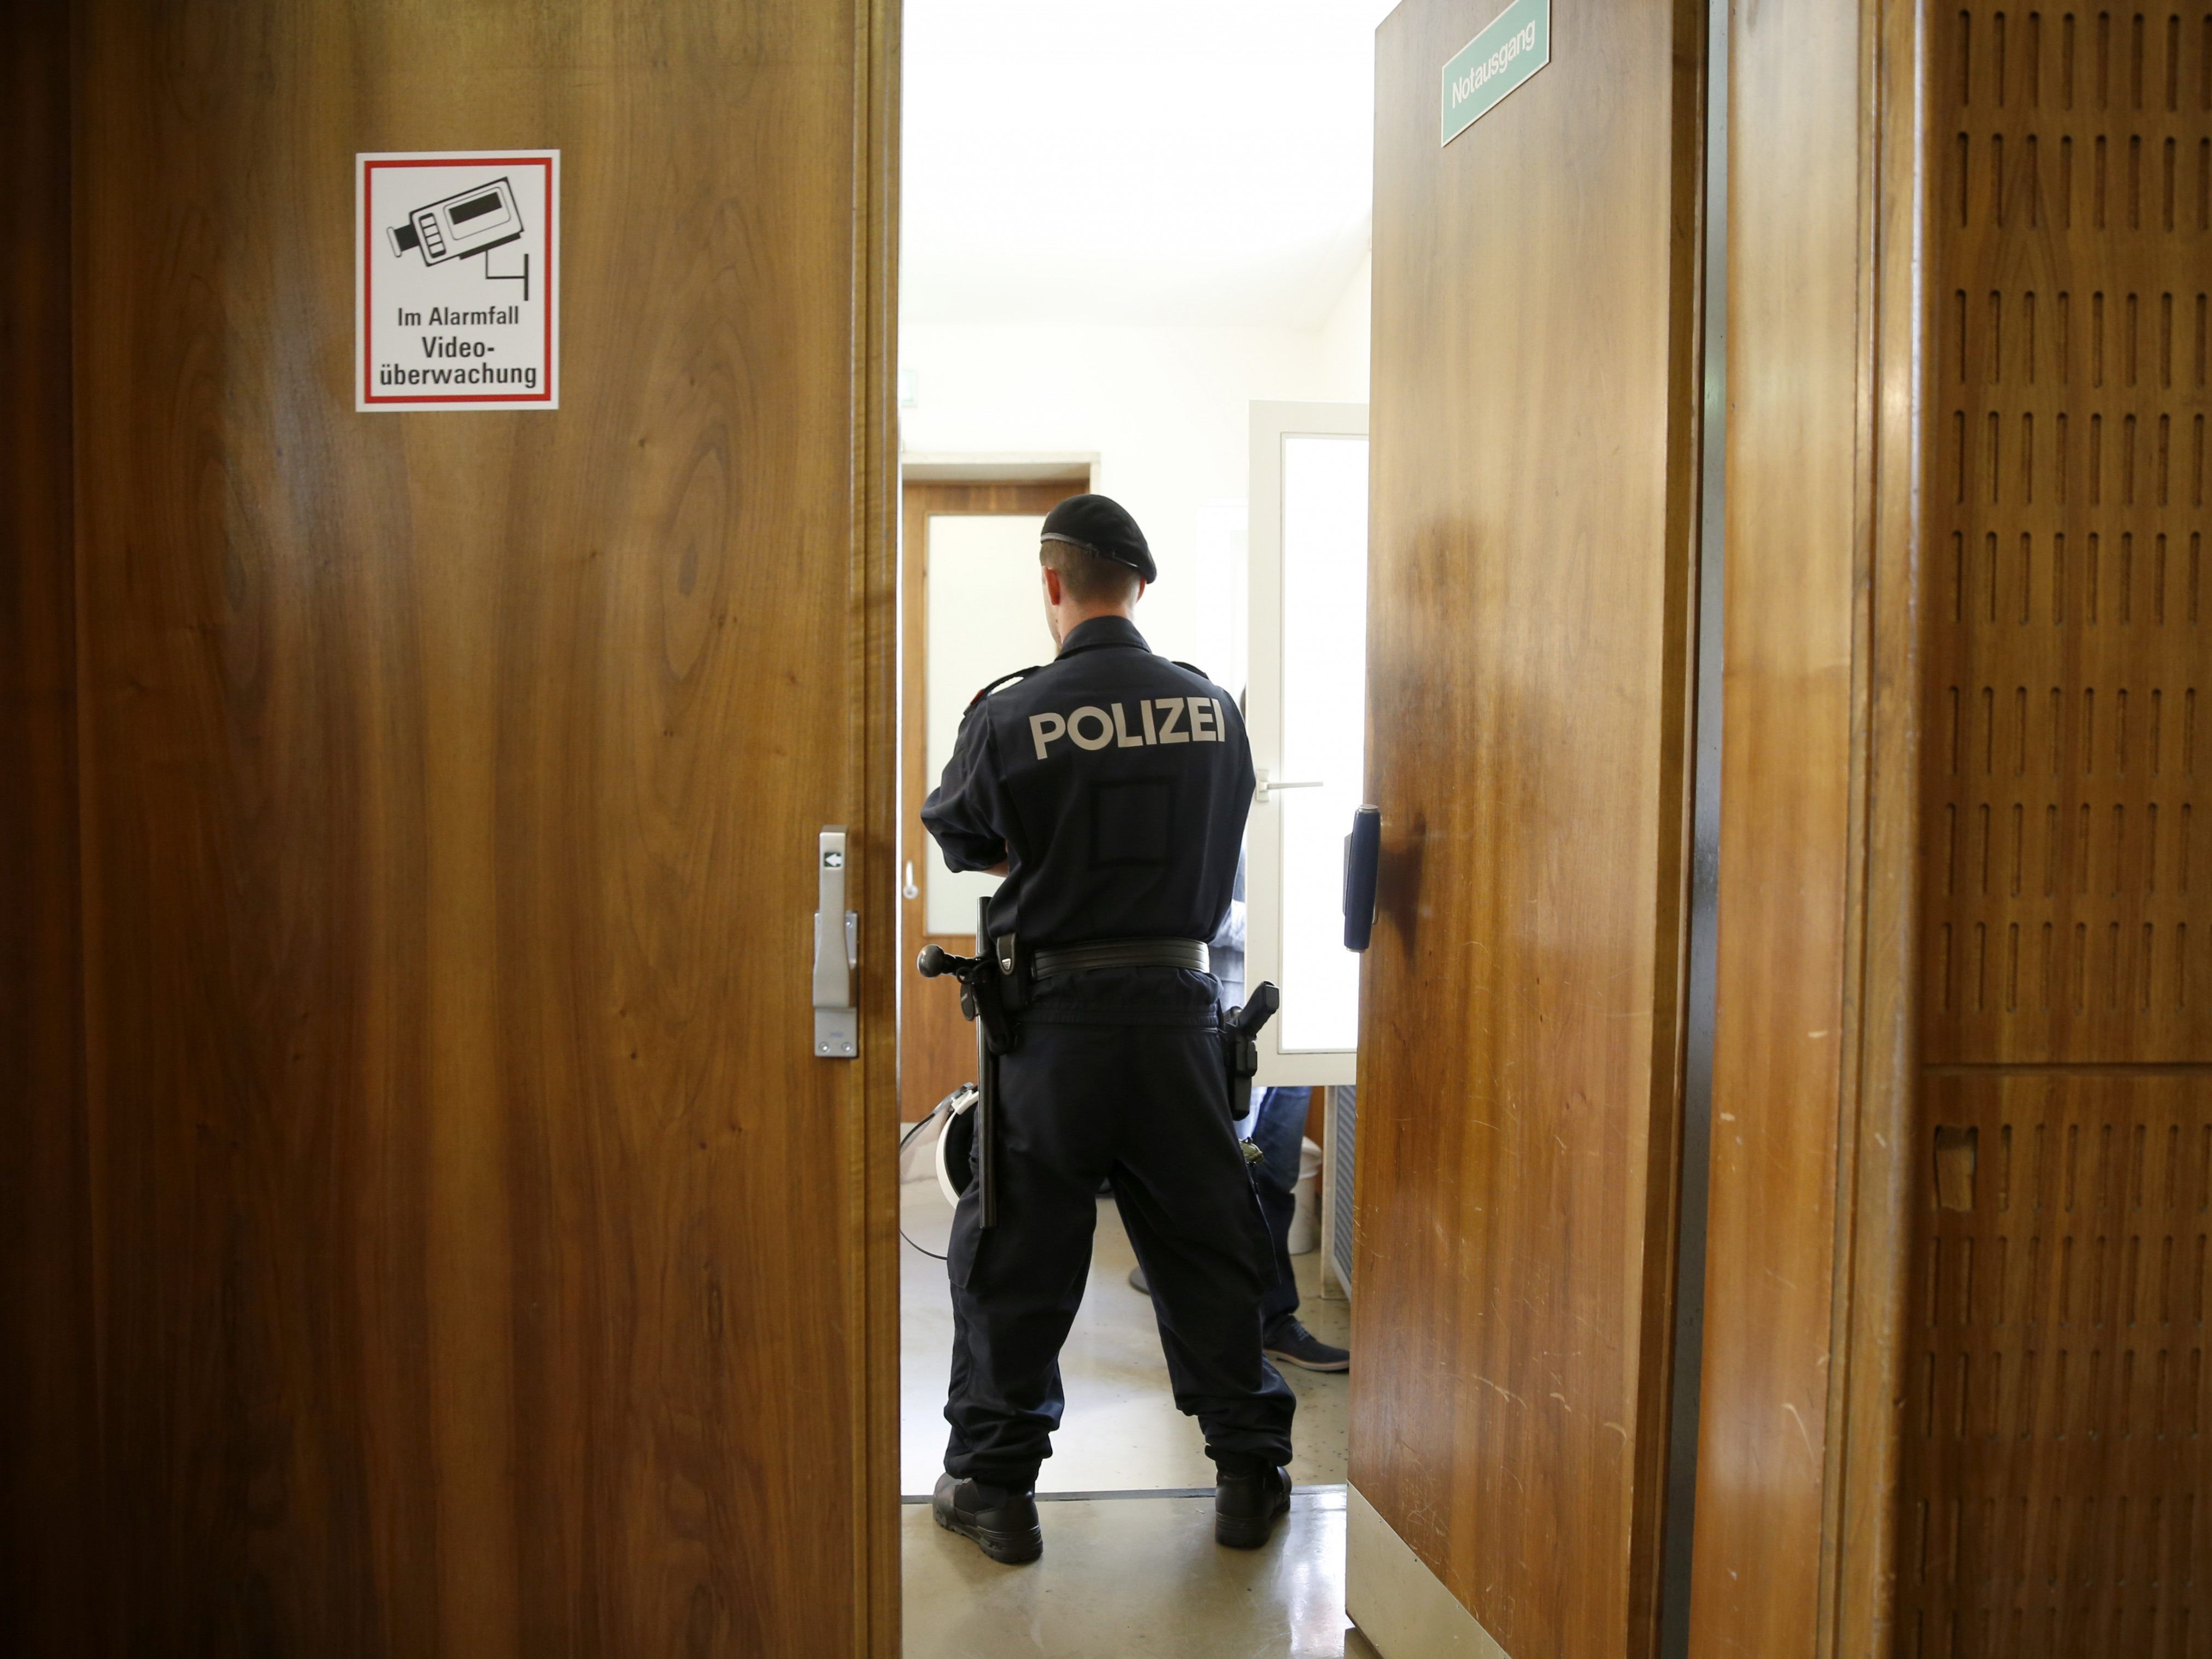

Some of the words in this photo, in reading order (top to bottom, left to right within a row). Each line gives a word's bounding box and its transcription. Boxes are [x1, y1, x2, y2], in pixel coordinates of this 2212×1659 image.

[1452, 20, 1535, 109] Notausgang
[398, 307, 421, 326] Im
[429, 306, 519, 325] Alarmfall
[422, 336, 495, 358] Video-
[380, 362, 537, 389] überwachung
[1029, 696, 1225, 760] POLIZEI
